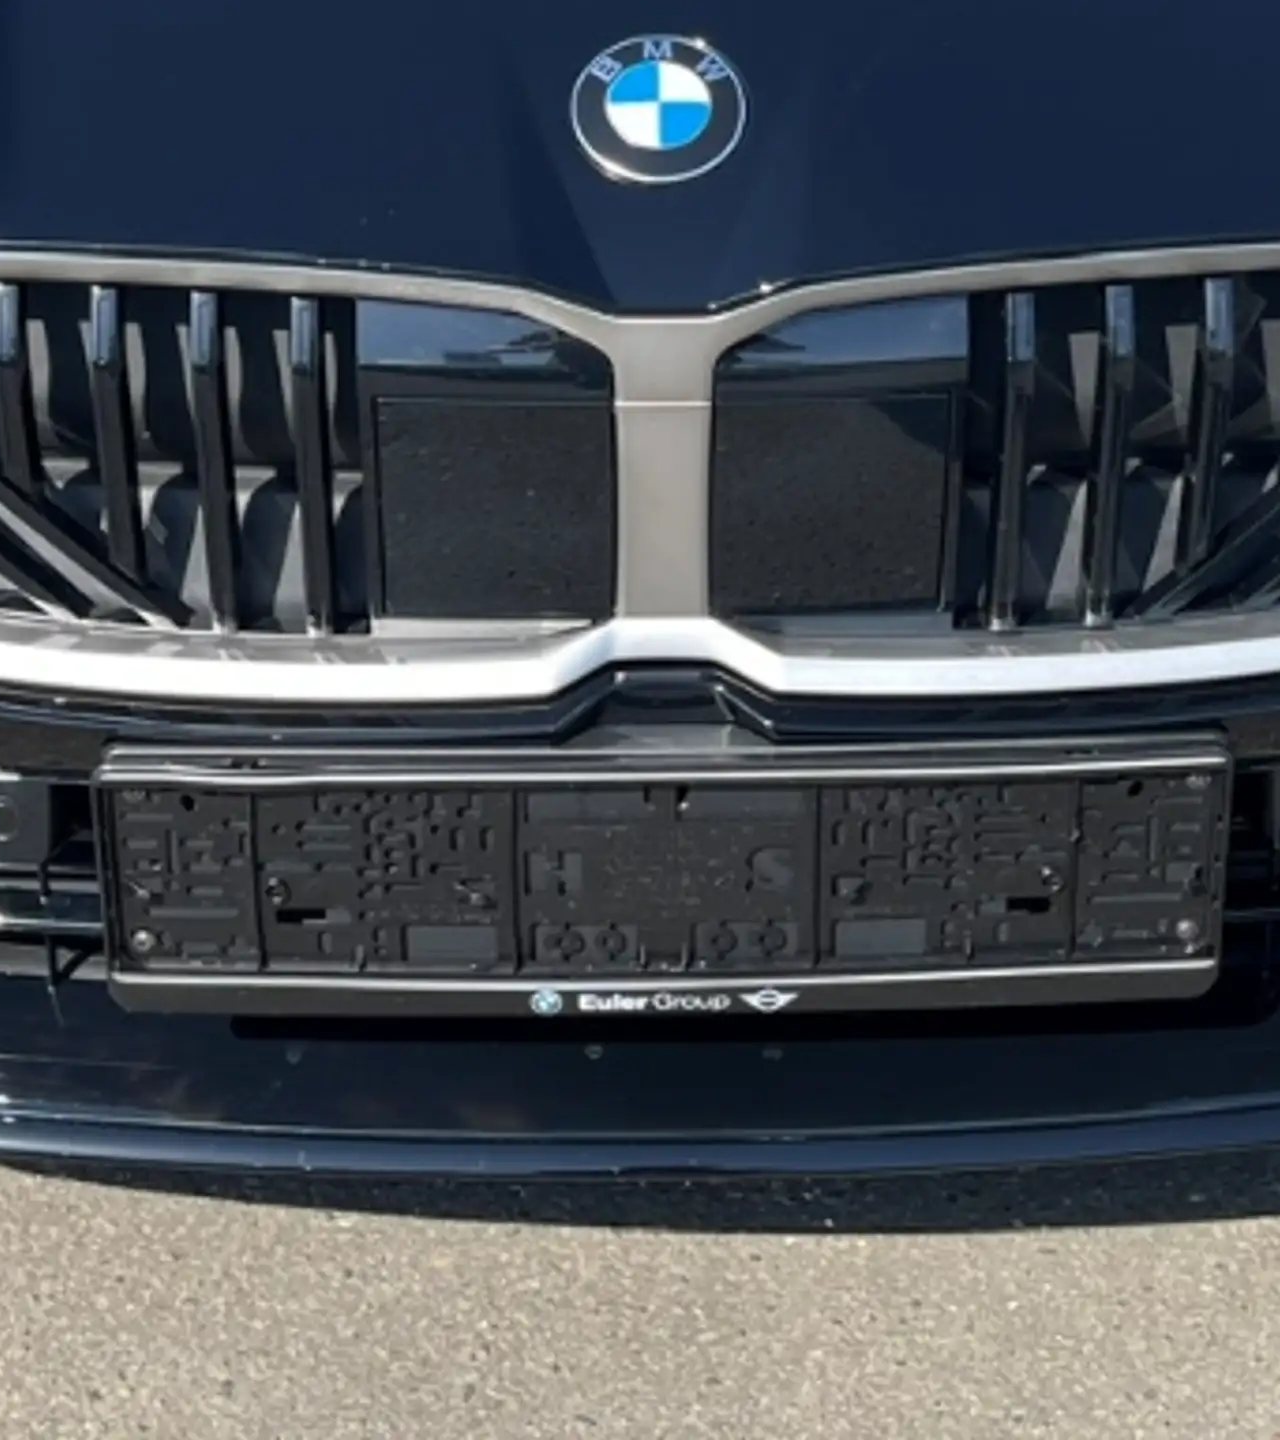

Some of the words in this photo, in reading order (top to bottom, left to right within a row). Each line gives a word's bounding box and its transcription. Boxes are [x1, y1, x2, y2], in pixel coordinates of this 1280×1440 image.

[589, 38, 729, 83] BMW
[577, 993, 649, 1011] Euler
[651, 992, 731, 1011] Group
